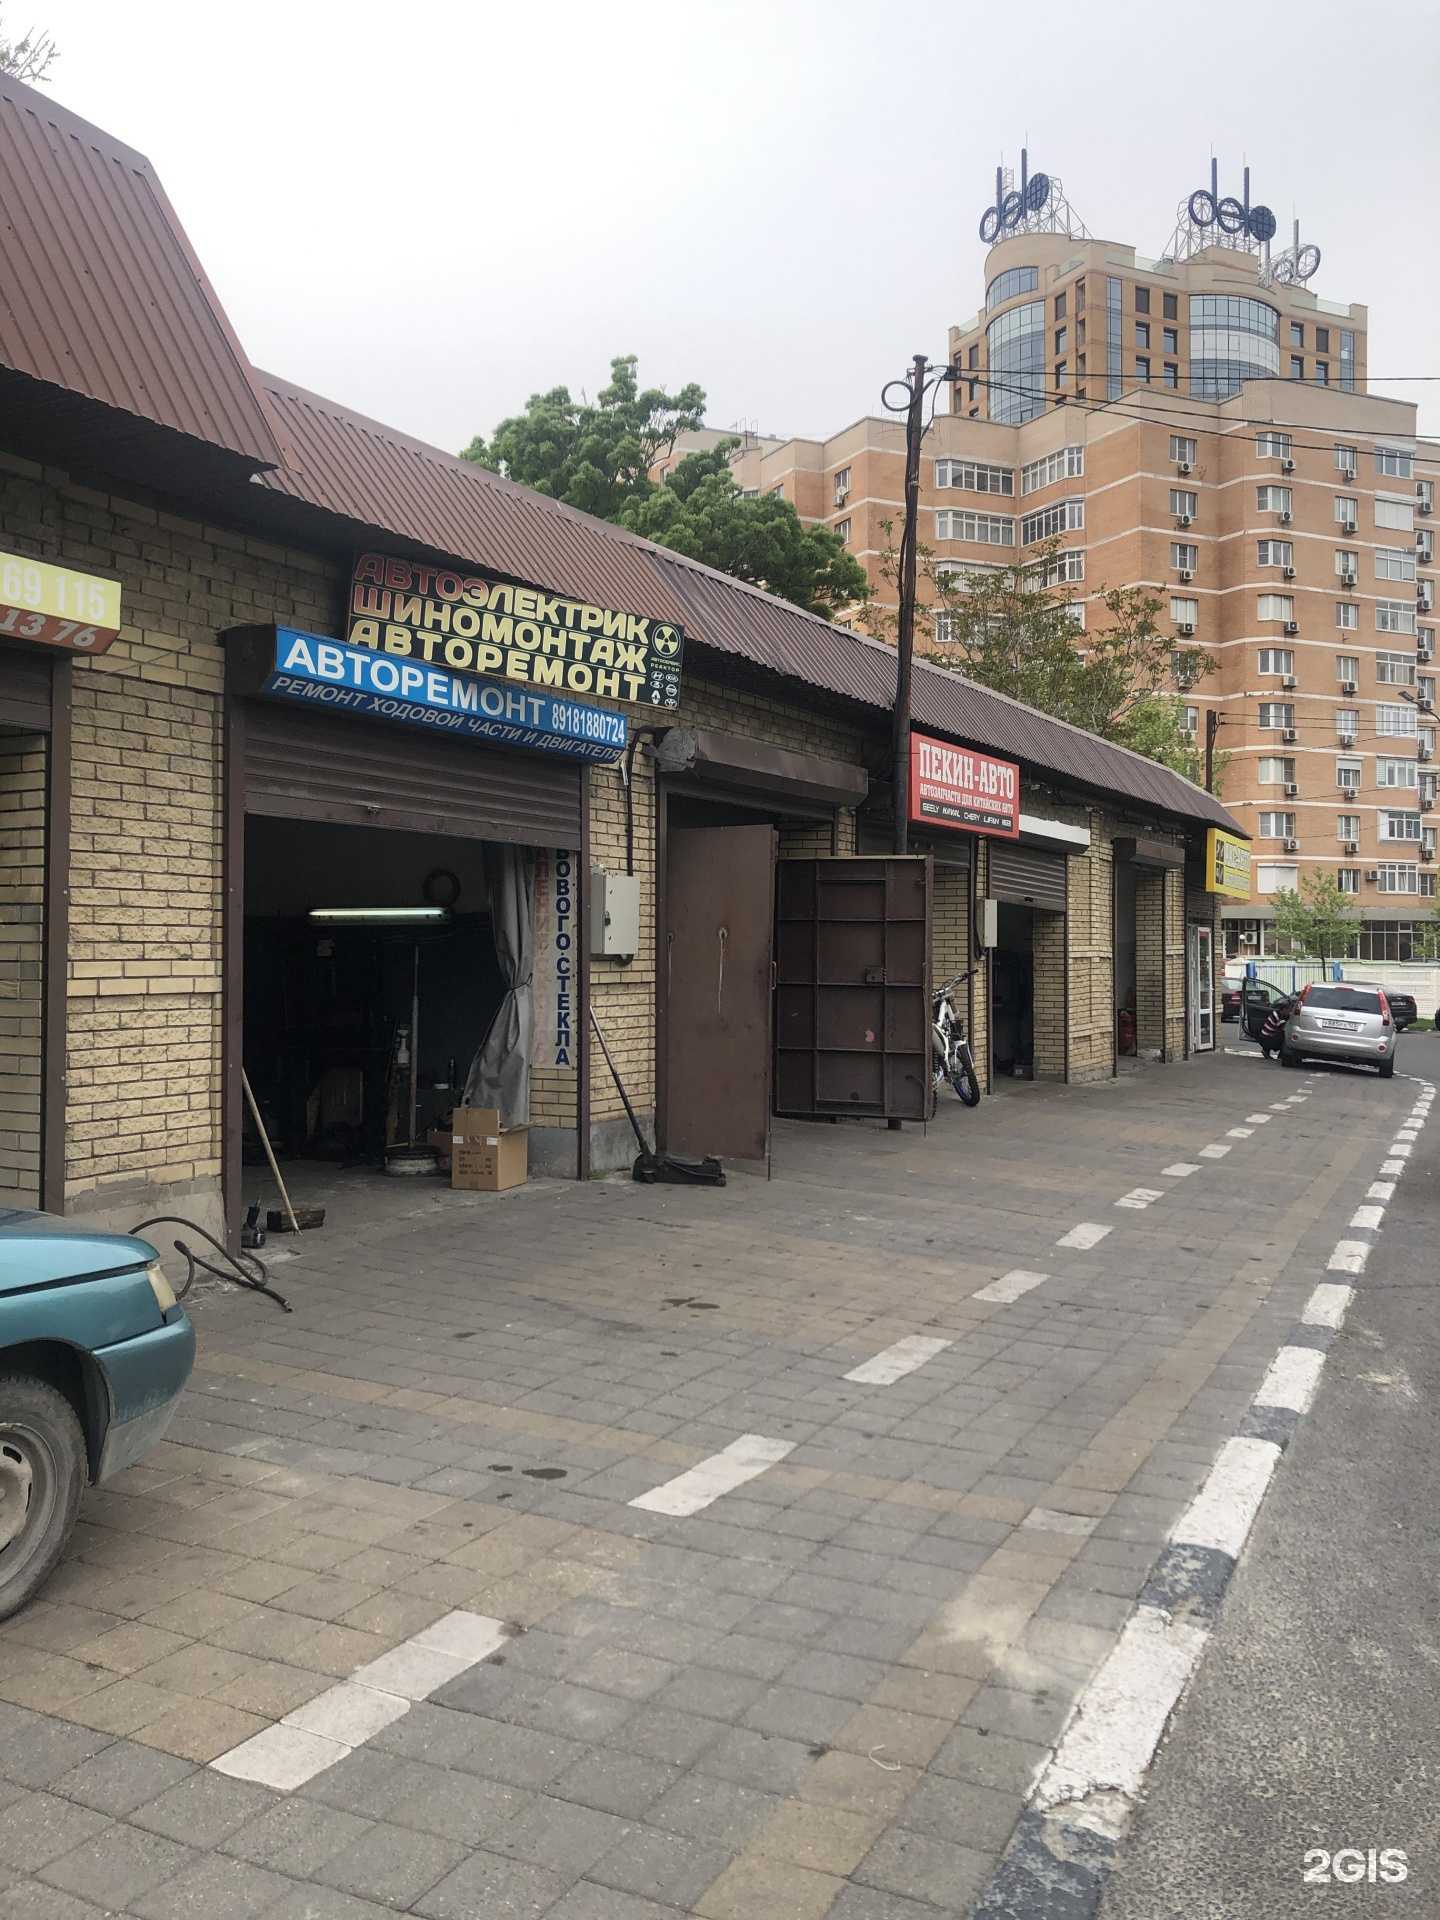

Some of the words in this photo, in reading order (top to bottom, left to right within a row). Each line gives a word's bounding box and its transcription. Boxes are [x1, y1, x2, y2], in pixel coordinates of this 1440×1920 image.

[3, 560, 43, 606] 69
[56, 574, 106, 622] 115
[52, 620, 98, 647] 76
[353, 584, 648, 674] ШИНОМОНТАЖ
[354, 553, 650, 645] АВТОЭЛЕКТРИК
[283, 638, 545, 725] АВТОРЕМОНТ
[552, 703, 625, 744] 89181880724
[349, 619, 646, 701] АВТОРЕМОНТ
[272, 676, 367, 707] РЕМОНТ
[367, 697, 465, 728] ХОДОВОЙ
[468, 717, 523, 741] ЧАСТИ
[522, 731, 538, 744] И
[536, 734, 624, 761] ДВИГАТЕЛЯ
[919, 741, 1014, 800] ПЕКИН-АВТО
[555, 957, 570, 1065] СТЕКЛА
